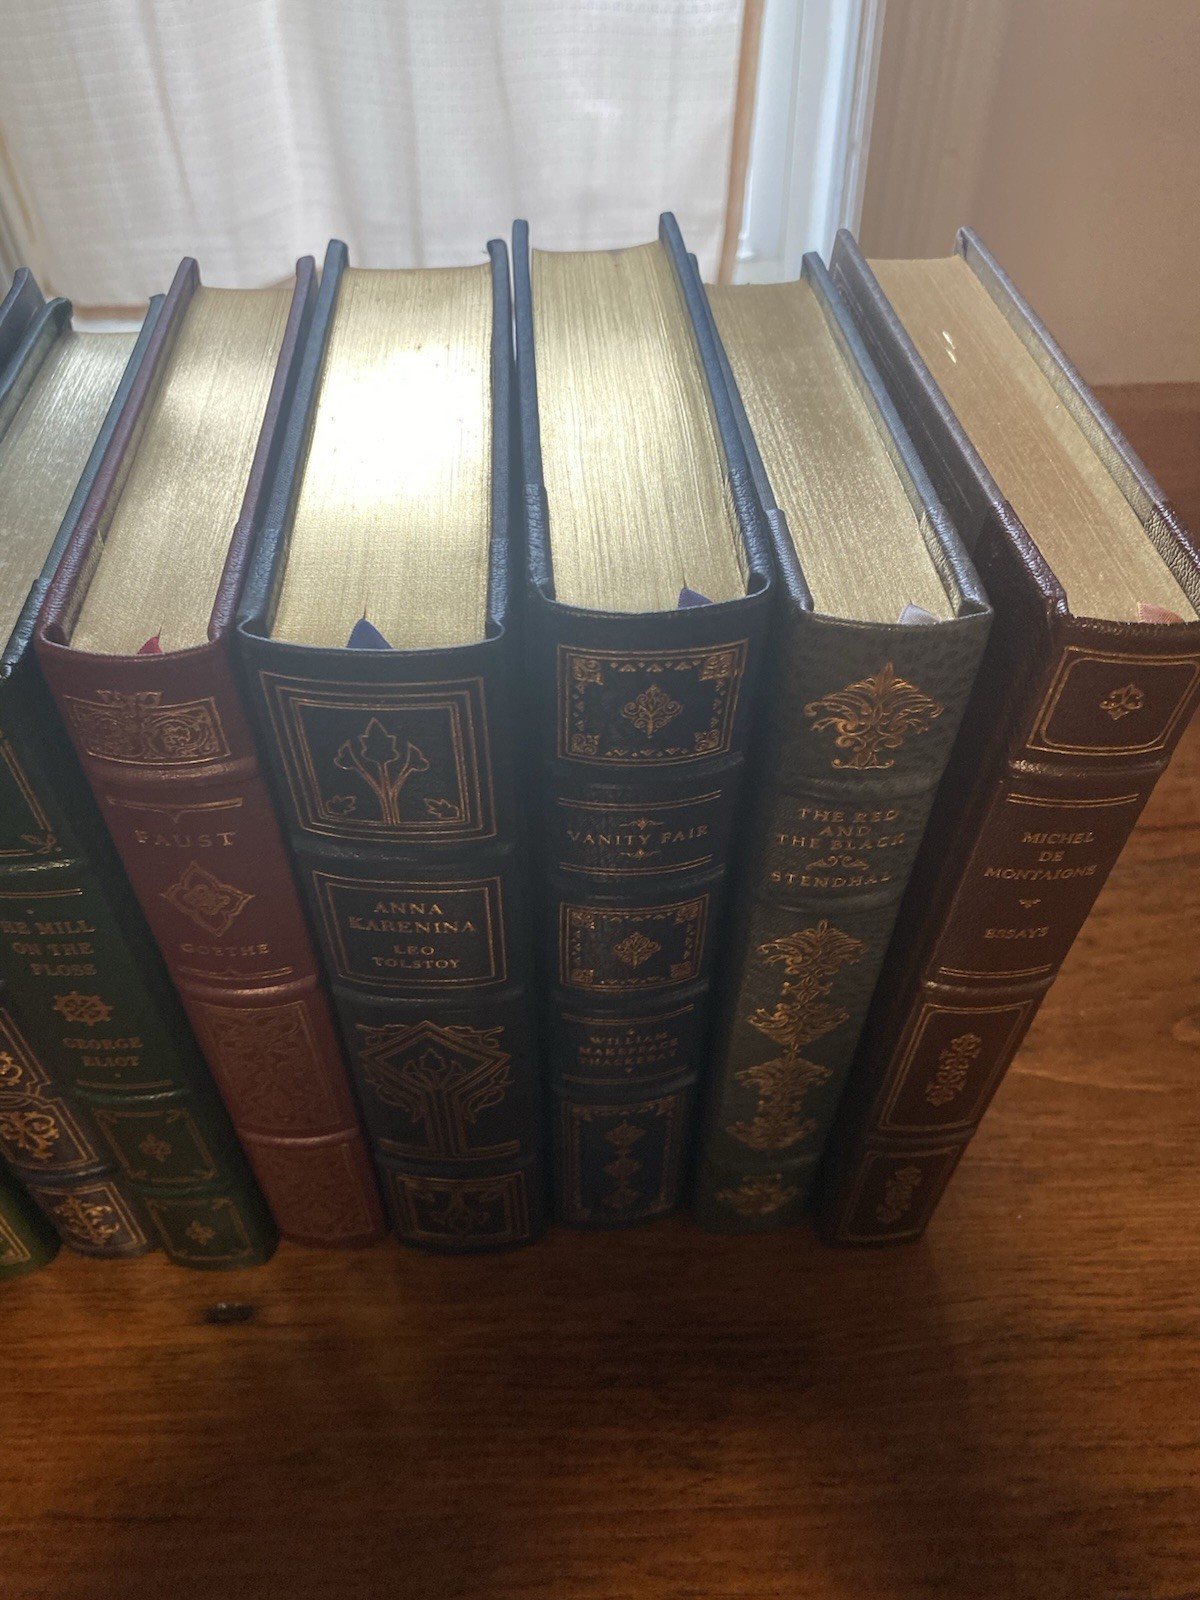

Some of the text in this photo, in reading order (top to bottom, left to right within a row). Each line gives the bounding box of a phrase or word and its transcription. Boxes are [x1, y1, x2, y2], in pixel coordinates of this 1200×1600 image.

[798, 808, 899, 823] THE RED
[567, 824, 710, 846] VANITY FAIR
[818, 825, 872, 837] AND
[1021, 831, 1096, 844] MICHEL
[134, 829, 236, 848] FAUST
[775, 832, 906, 850] THE BLACK
[1037, 850, 1065, 862] DE
[769, 870, 892, 888] STENDHAL
[373, 901, 443, 915] ANNA
[34, 920, 96, 935] MILL
[349, 916, 477, 935] KARENINA
[983, 925, 1050, 939] ESSAYS
[11, 942, 95, 956] ON THE
[179, 942, 270, 957] GOETHE
[392, 944, 435, 955] LEO
[30, 963, 98, 976] FLOSS
[372, 956, 460, 970] TOLSTOY
[62, 1036, 144, 1050] GEORGE
[589, 1031, 668, 1046] WILLIAM
